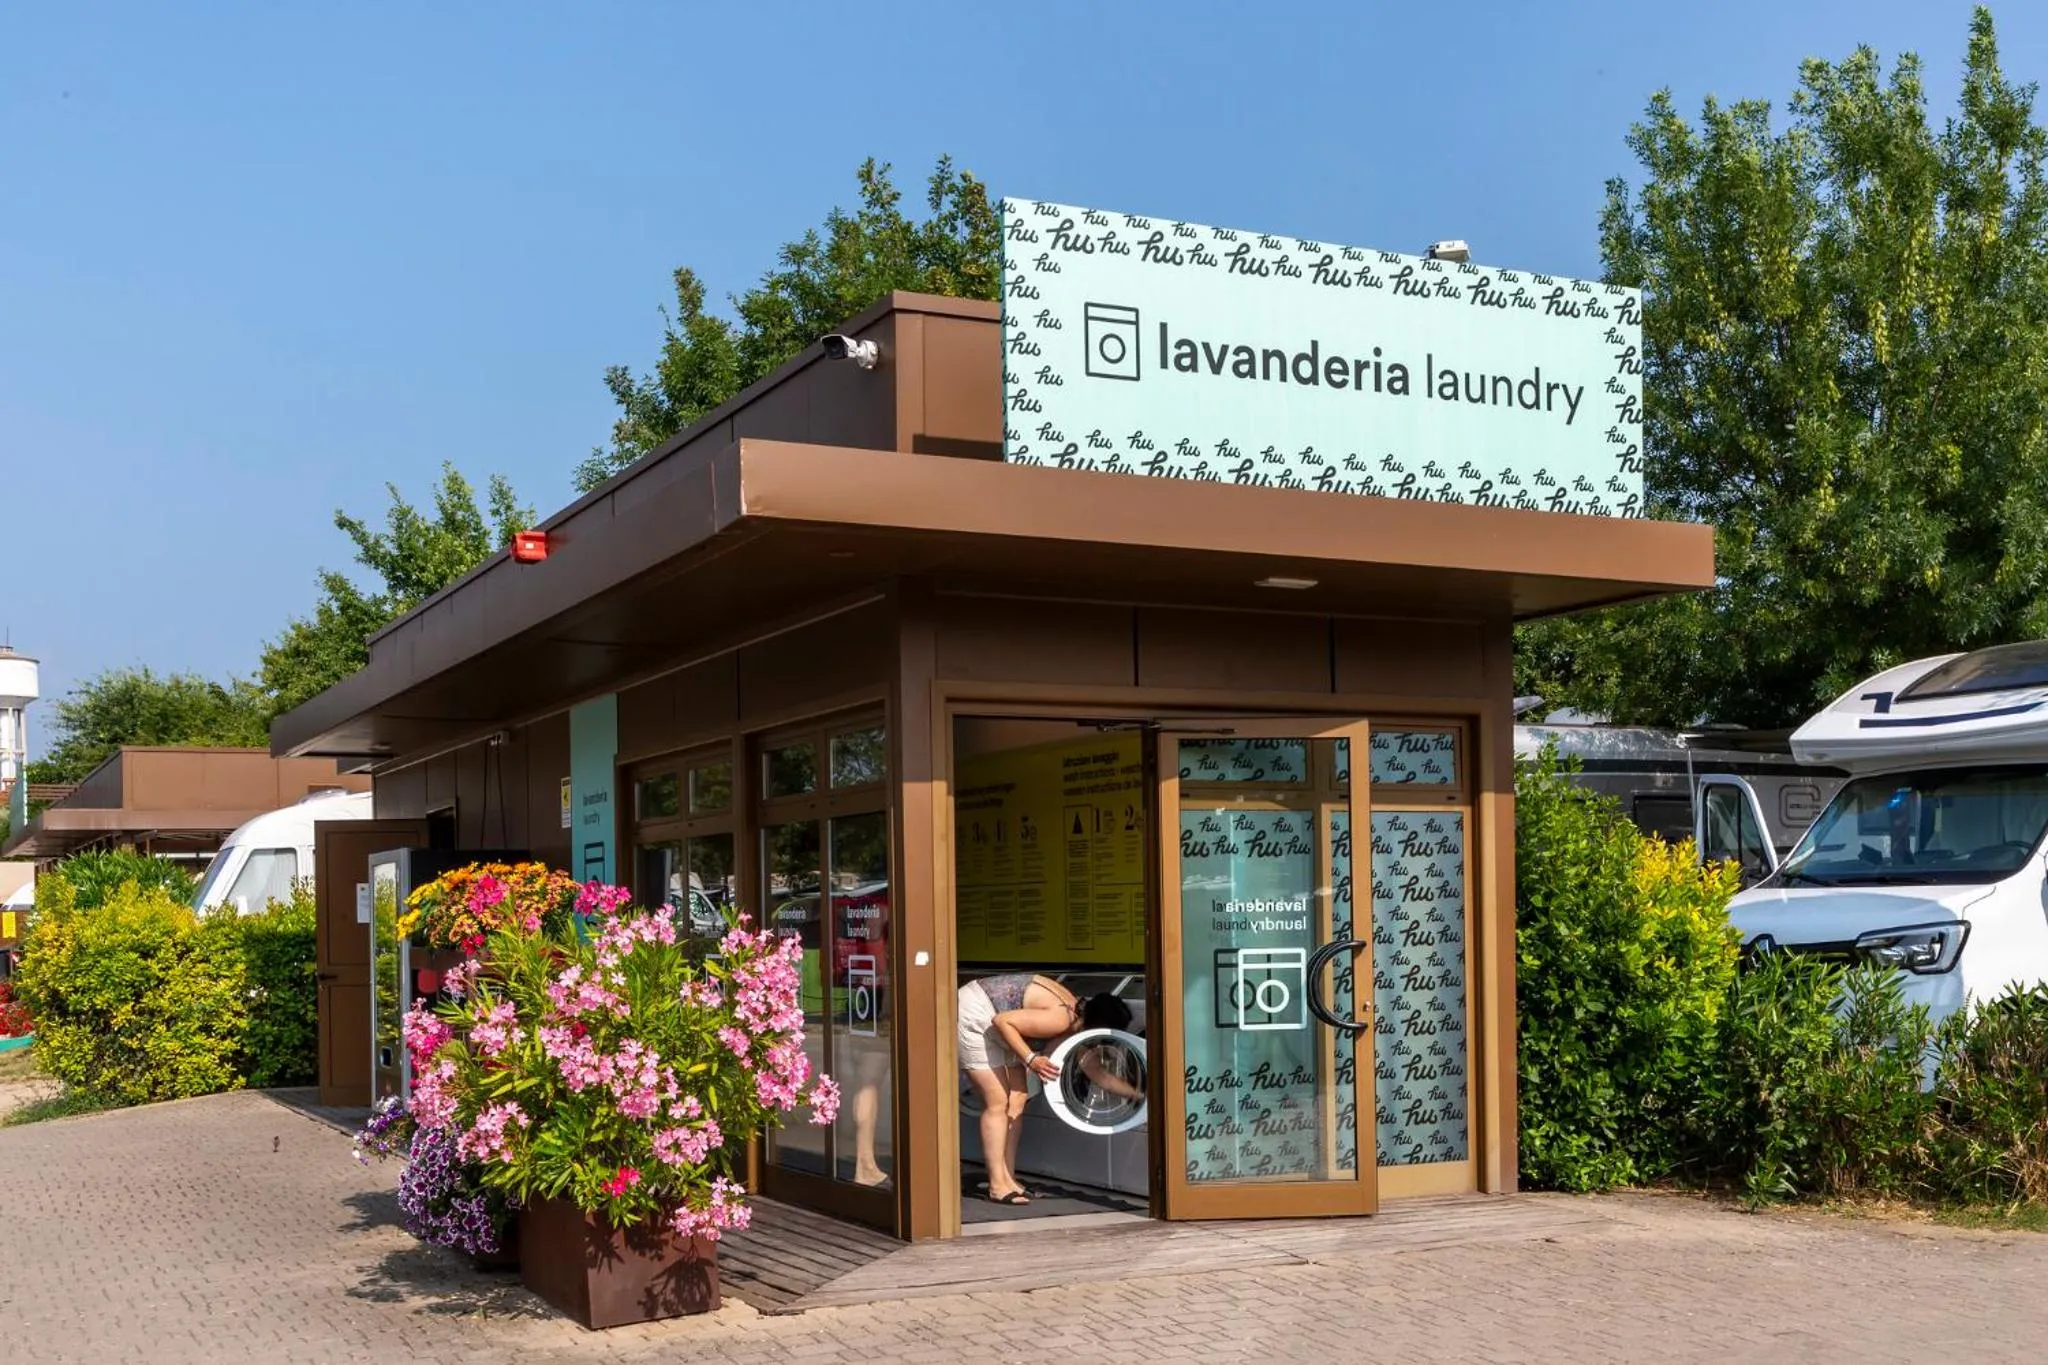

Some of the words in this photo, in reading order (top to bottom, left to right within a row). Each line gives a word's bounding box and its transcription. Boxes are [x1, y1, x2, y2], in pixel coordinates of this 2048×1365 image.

[1032, 202, 1060, 217] hu
[1082, 210, 1108, 226] hu
[1123, 215, 1150, 230] hu
[1172, 223, 1196, 238] hu
[1211, 228, 1237, 242] hu
[1258, 235, 1282, 250] hu
[1296, 240, 1320, 253] hu
[1340, 247, 1363, 261] hu
[1379, 252, 1401, 264] hu
[1420, 258, 1442, 272] hu
[1458, 263, 1478, 275] hu
[1496, 269, 1518, 283] hu
[1533, 274, 1553, 286] hu
[1570, 280, 1591, 293] hu
[1605, 285, 1625, 296] hu
[1004, 219, 1038, 243] hu
[1046, 218, 1094, 254] hu
[1098, 231, 1130, 255] hu
[1137, 231, 1184, 266] hu
[1186, 243, 1217, 267] hu
[1224, 243, 1269, 277] hu
[1272, 255, 1302, 278] hu
[1308, 254, 1351, 288] hu
[1354, 266, 1382, 288] hu
[1389, 265, 1430, 298] hu
[1433, 277, 1461, 299] hu
[1467, 276, 1507, 308] hu
[1509, 287, 1536, 309] hu
[1542, 286, 1580, 318] hu
[1582, 297, 1608, 318] hu
[1033, 253, 1060, 273] hu
[1004, 275, 1040, 300] hu
[1034, 309, 1062, 330] hu
[1005, 332, 1041, 356] hu
[1604, 327, 1625, 345] hu
[1034, 366, 1063, 386] hu
[1160, 322, 1409, 396] lavanderia
[1427, 354, 1584, 425] laundry
[1604, 376, 1626, 394] hu
[1006, 388, 1042, 413] hu
[1605, 426, 1626, 444] hu
[1036, 422, 1064, 442] hu
[1086, 430, 1112, 449] hu
[1127, 431, 1154, 450] hu
[1174, 438, 1200, 457] hu
[1214, 438, 1240, 458] hu
[1260, 446, 1285, 464] hu
[1299, 446, 1323, 466] hu
[1342, 453, 1367, 472] hu
[1380, 454, 1404, 472] hu
[1422, 460, 1445, 478] hu
[1458, 461, 1481, 480] hu
[1499, 468, 1520, 485] hu
[1533, 468, 1555, 486] hu
[1572, 475, 1594, 492] hu
[1606, 475, 1628, 493] hu
[1198, 755, 1219, 770] hu
[1231, 753, 1255, 769] hu
[1270, 756, 1292, 772] hu
[1385, 756, 1406, 771] hu
[1422, 759, 1442, 773] hu
[1200, 817, 1221, 832] hu
[1234, 814, 1255, 831] hu
[1272, 817, 1293, 833] hu
[1387, 816, 1408, 832] hu
[1423, 818, 1444, 833] hu
[1180, 830, 1209, 857] hu
[1212, 835, 1239, 855] hu
[1244, 830, 1282, 858] hu
[1284, 835, 1310, 855] hu
[1371, 836, 1392, 854] hu
[1398, 830, 1433, 858] hu
[1435, 836, 1459, 854] hu
[1388, 860, 1408, 876] hu
[1424, 862, 1444, 878] hu
[1372, 880, 1394, 900] hu
[1398, 875, 1434, 902] hu
[1436, 880, 1460, 898] hu
[1388, 905, 1409, 921] hu
[1425, 907, 1445, 922] hu
[1372, 926, 1394, 944] hu
[1399, 920, 1435, 948] hu
[1436, 925, 1461, 944] hu
[1388, 950, 1410, 966] hu
[1426, 951, 1446, 967] hu
[1374, 971, 1394, 990] hu
[1400, 965, 1435, 992] hu
[1437, 969, 1461, 987] hu
[1389, 995, 1411, 1012] hu
[1426, 996, 1446, 1011] hu
[1374, 1016, 1396, 1034] hu
[1400, 1009, 1436, 1036] hu
[1438, 1013, 1462, 1032] hu
[1390, 1040, 1412, 1056] hu
[1427, 1040, 1446, 1056] hu
[1185, 1065, 1213, 1094] hu
[1216, 1069, 1243, 1090] hu
[1249, 1061, 1287, 1091] hu
[1289, 1065, 1314, 1084] hu
[1375, 1061, 1396, 1080] hu
[1401, 1054, 1437, 1082] hu
[1439, 1058, 1462, 1076] hu
[1392, 1085, 1412, 1100] hu
[1428, 1086, 1448, 1100] hu
[1204, 1098, 1226, 1114] hu
[1239, 1094, 1260, 1111] hu
[1376, 1106, 1397, 1124] hu
[1402, 1098, 1438, 1126] hu
[1440, 1102, 1463, 1121] hu
[1186, 1112, 1215, 1140] hu
[1216, 1115, 1244, 1136] hu
[1250, 1108, 1287, 1137] hu
[1390, 1130, 1412, 1146] hu
[1428, 1130, 1448, 1146] hu
[1205, 1145, 1227, 1162] hu
